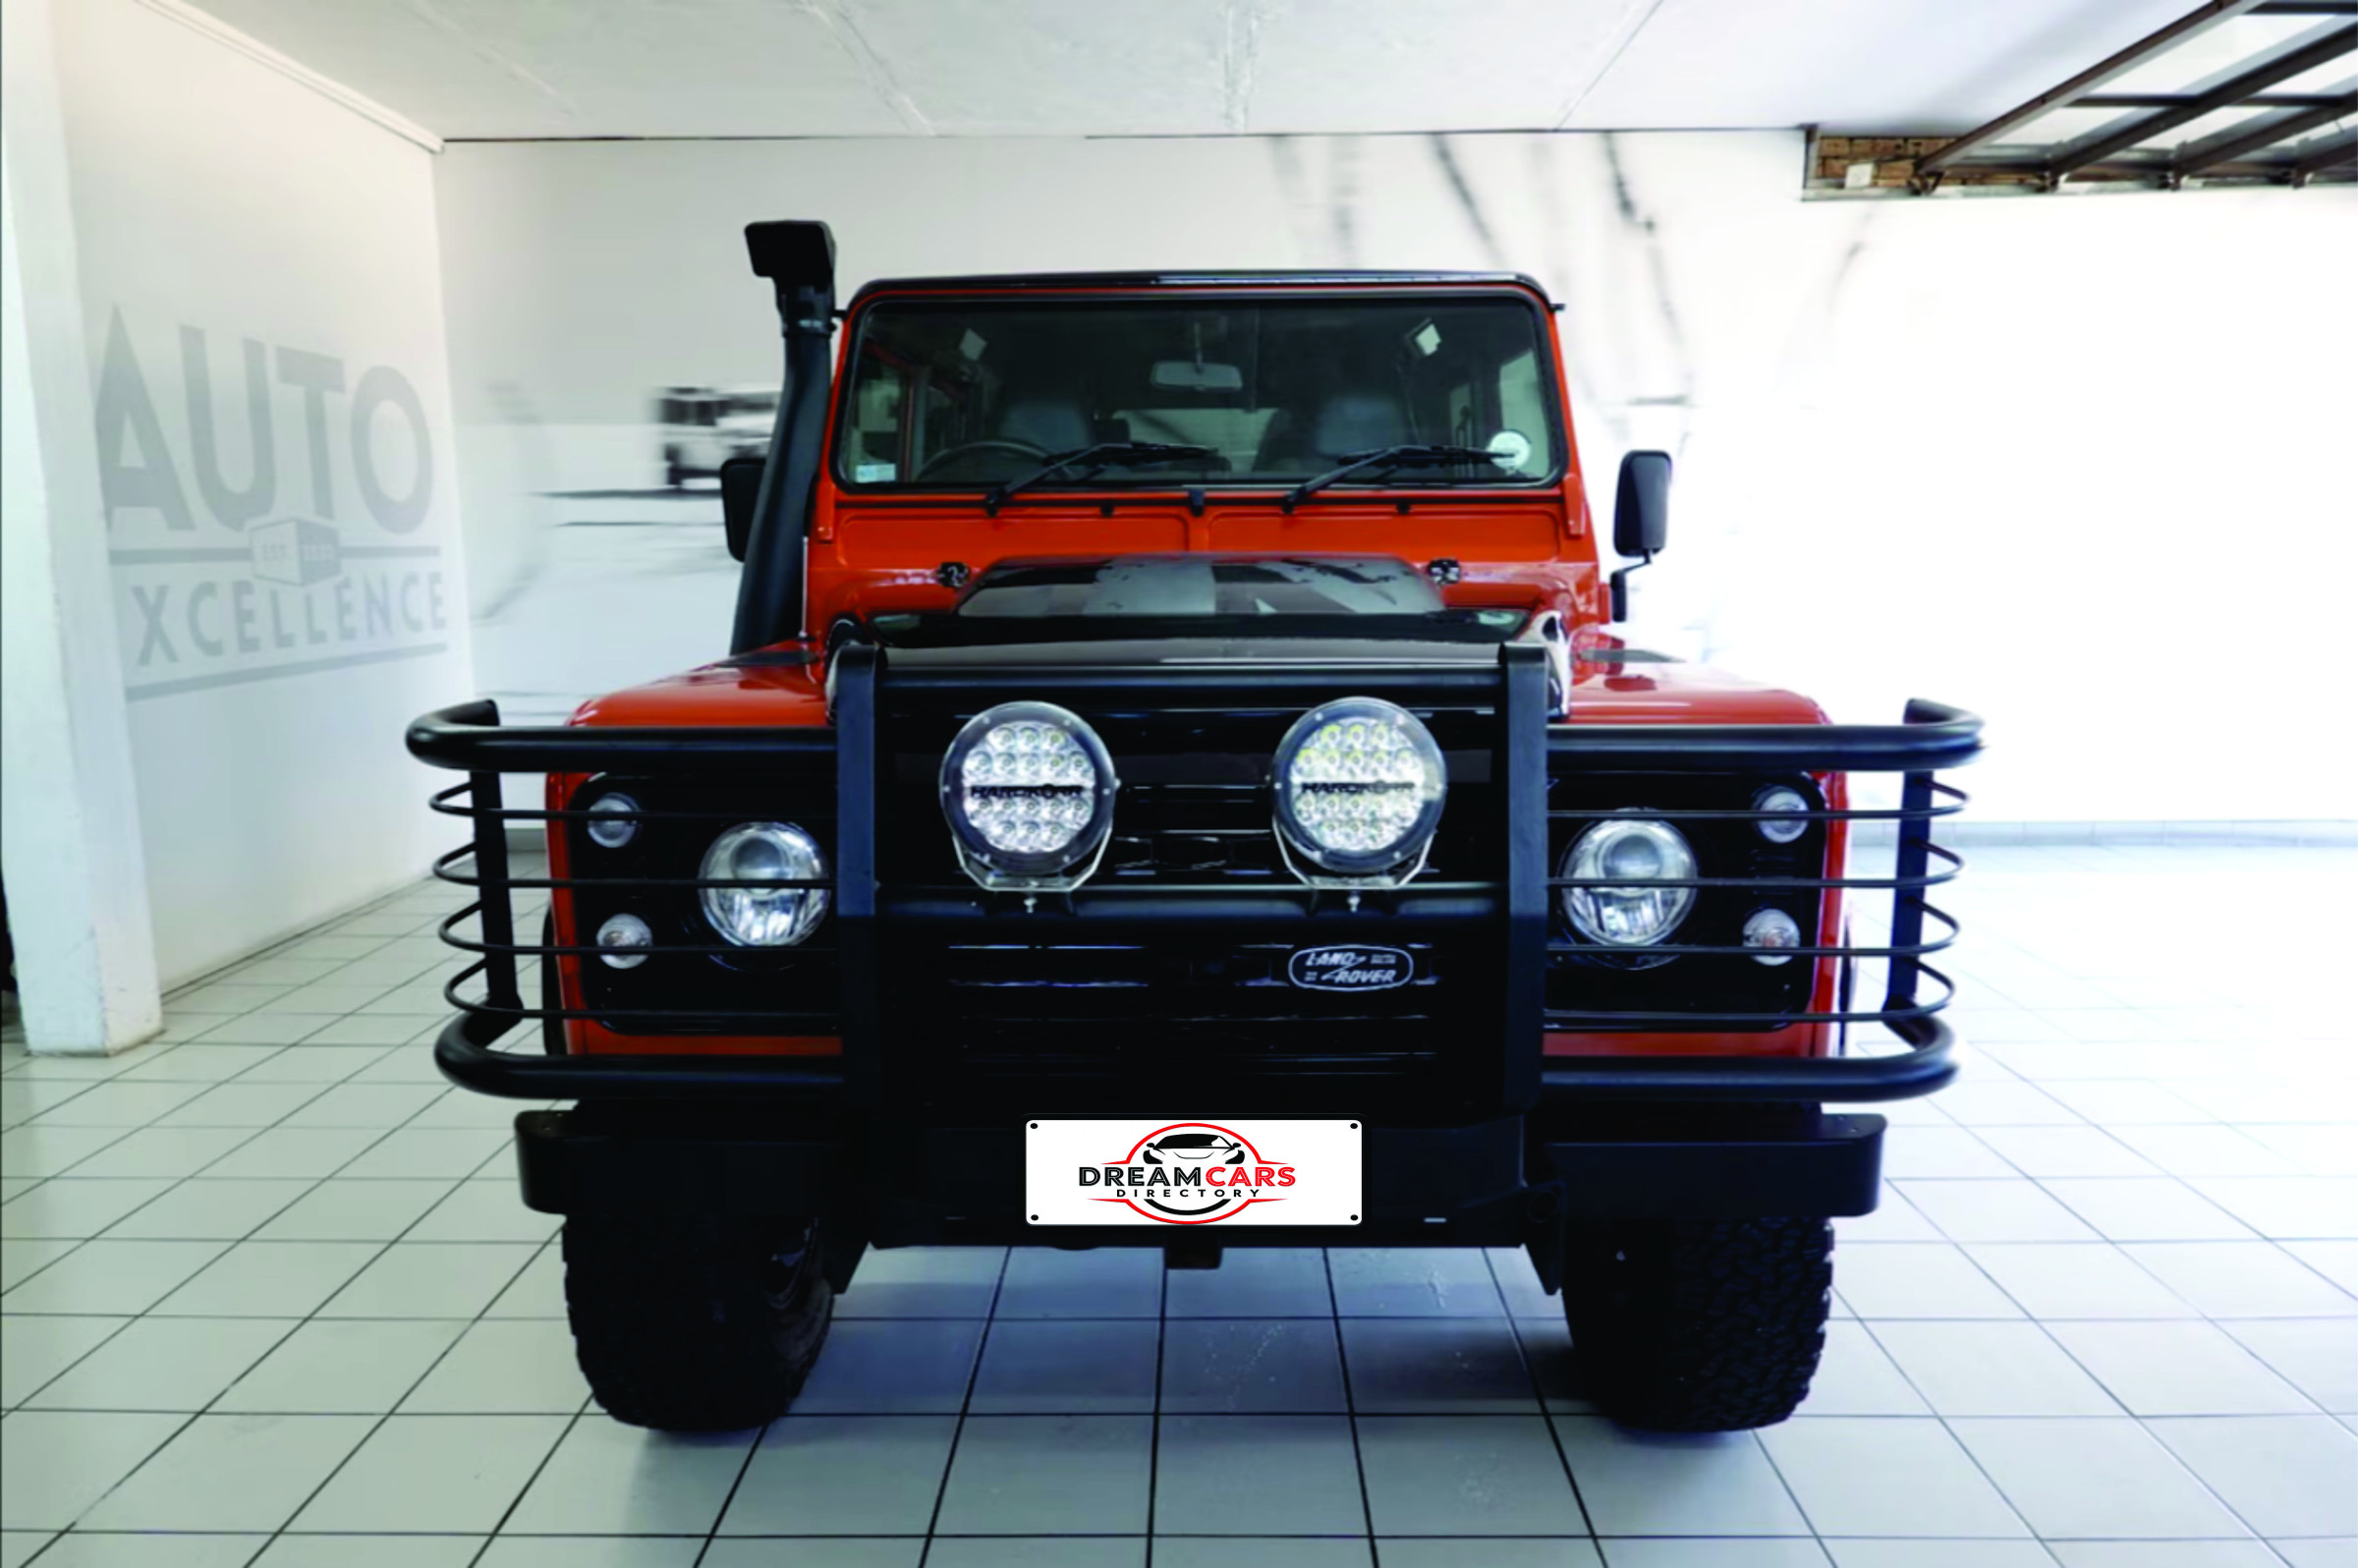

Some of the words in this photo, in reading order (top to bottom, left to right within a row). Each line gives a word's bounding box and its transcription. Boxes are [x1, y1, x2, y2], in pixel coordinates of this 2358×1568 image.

[95, 301, 433, 535] AUTO
[130, 571, 448, 666] XCELLENCE
[1305, 951, 1357, 967] LAND
[1333, 969, 1397, 983] ROVER
